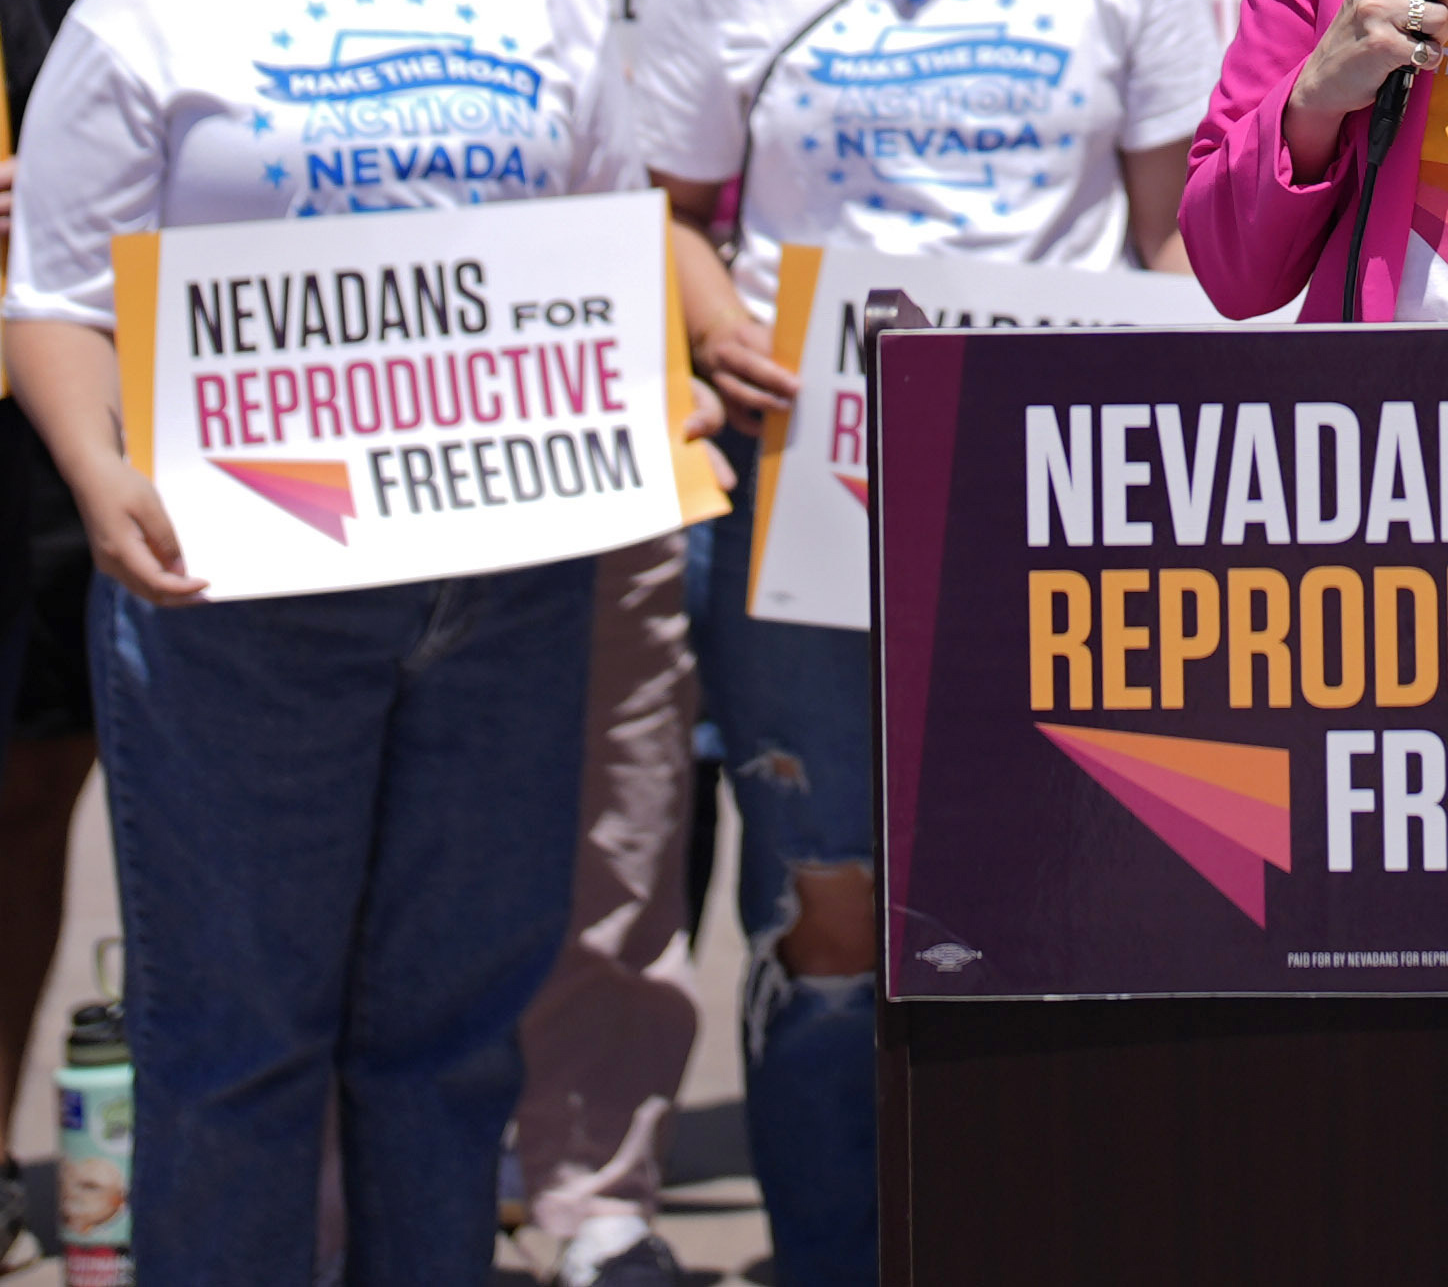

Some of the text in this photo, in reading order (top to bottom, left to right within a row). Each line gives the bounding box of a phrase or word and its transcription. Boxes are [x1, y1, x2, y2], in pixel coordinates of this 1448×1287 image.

[289, 54, 535, 97] MAKE THE ROAD
[830, 43, 1061, 78] MAKE THE ROAD
[302, 89, 538, 144] ACTION
[837, 123, 1042, 159] NEVADA
[306, 142, 527, 191] NEVADA
[186, 258, 613, 357] NEVADANS FOR
[194, 337, 627, 451] REPRODUCTIVE
[368, 427, 644, 517] FREEDOM
[1288, 951, 1310, 968] PAID
[1312, 951, 1331, 968] FOR
[1333, 951, 1345, 968] BY
[1348, 951, 1399, 968] NEVADANS
[1401, 951, 1419, 968] FOR
